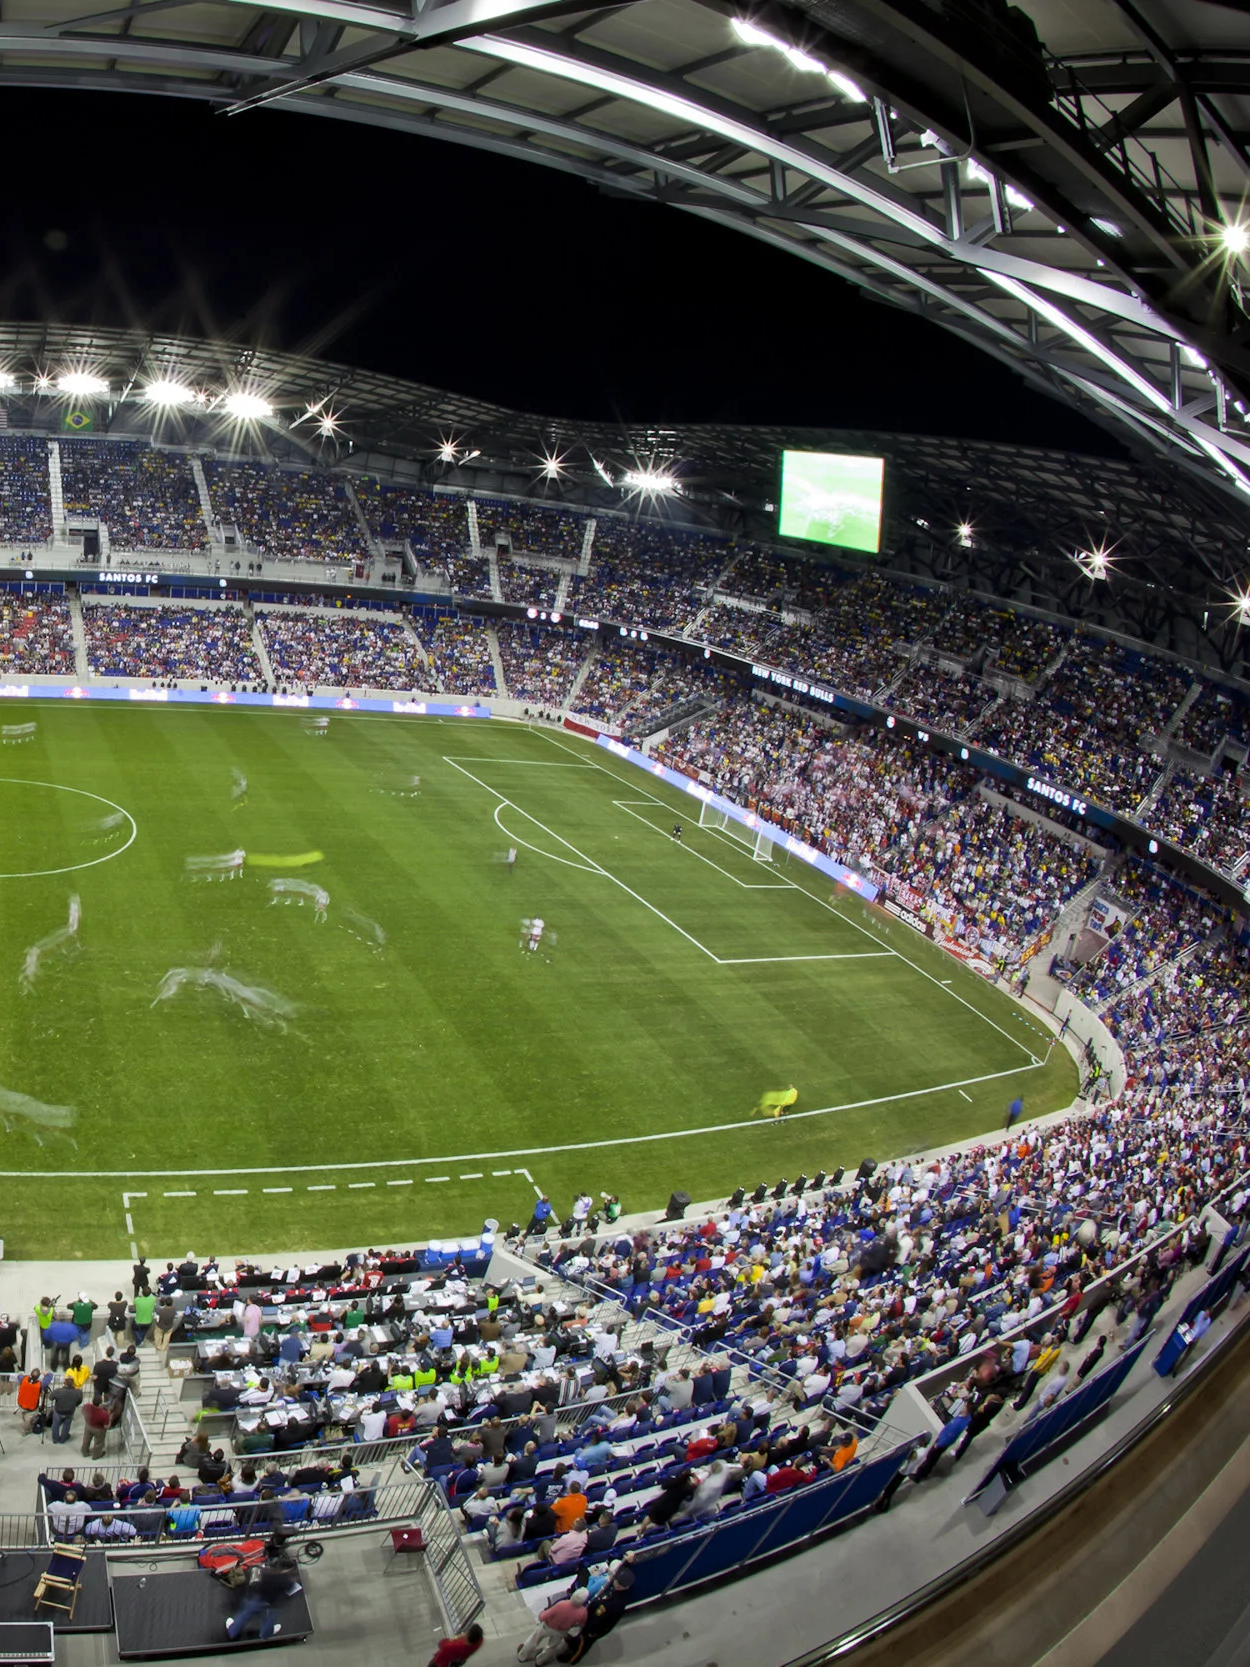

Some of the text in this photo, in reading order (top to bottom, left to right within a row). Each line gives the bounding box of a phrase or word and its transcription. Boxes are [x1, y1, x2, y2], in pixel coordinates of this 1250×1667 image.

[99, 572, 158, 584] SANTOS FC
[752, 665, 834, 703] NEW YORK RED BULLS
[1027, 777, 1087, 815] SANTOS FC
[900, 910, 927, 933] adidas
